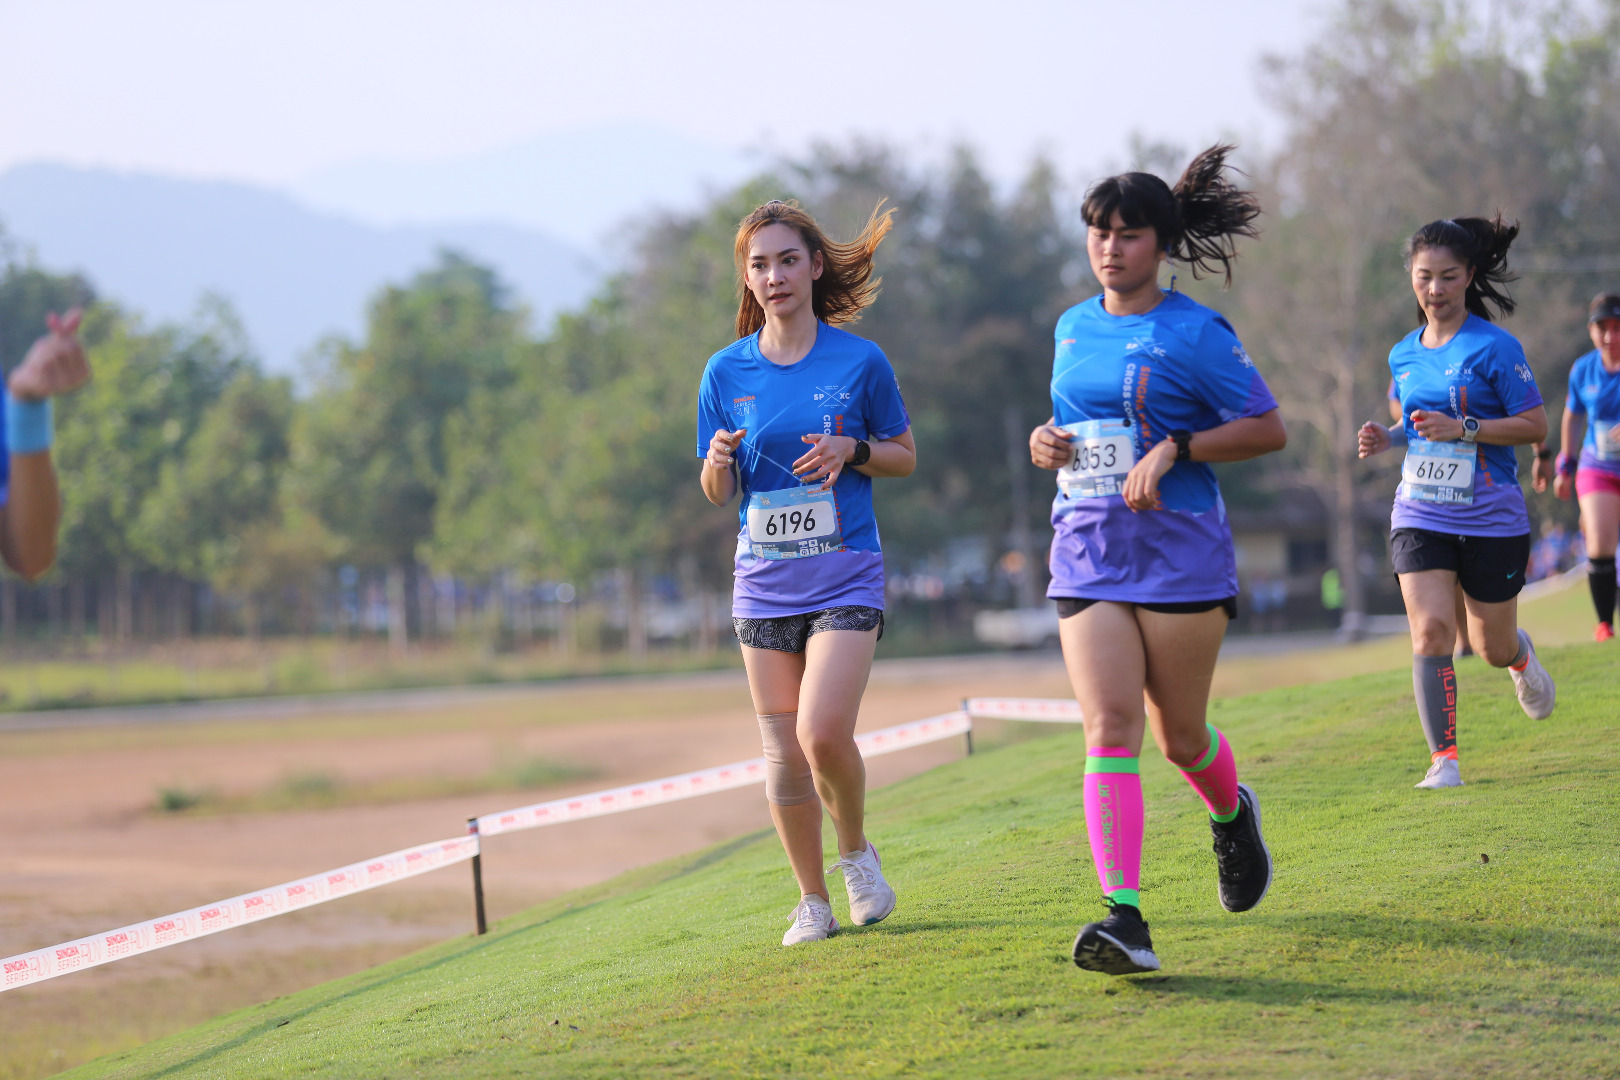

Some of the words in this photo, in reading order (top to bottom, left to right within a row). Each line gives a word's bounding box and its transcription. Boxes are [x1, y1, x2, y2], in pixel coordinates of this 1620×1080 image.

[1122, 363, 1136, 398] CROSS
[1136, 365, 1151, 411] SINGHA
[823, 414, 831, 436] CRO
[835, 414, 843, 436] SIN
[1072, 443, 1116, 472] 6353
[1416, 461, 1459, 481] 6167
[766, 508, 816, 537] 6196
[1437, 666, 1456, 740] kalenji
[56, 946, 79, 960] SINGHA
[57, 956, 81, 971] SERIES
[4, 959, 28, 974] SINGHA
[5, 970, 29, 985] SERIES
